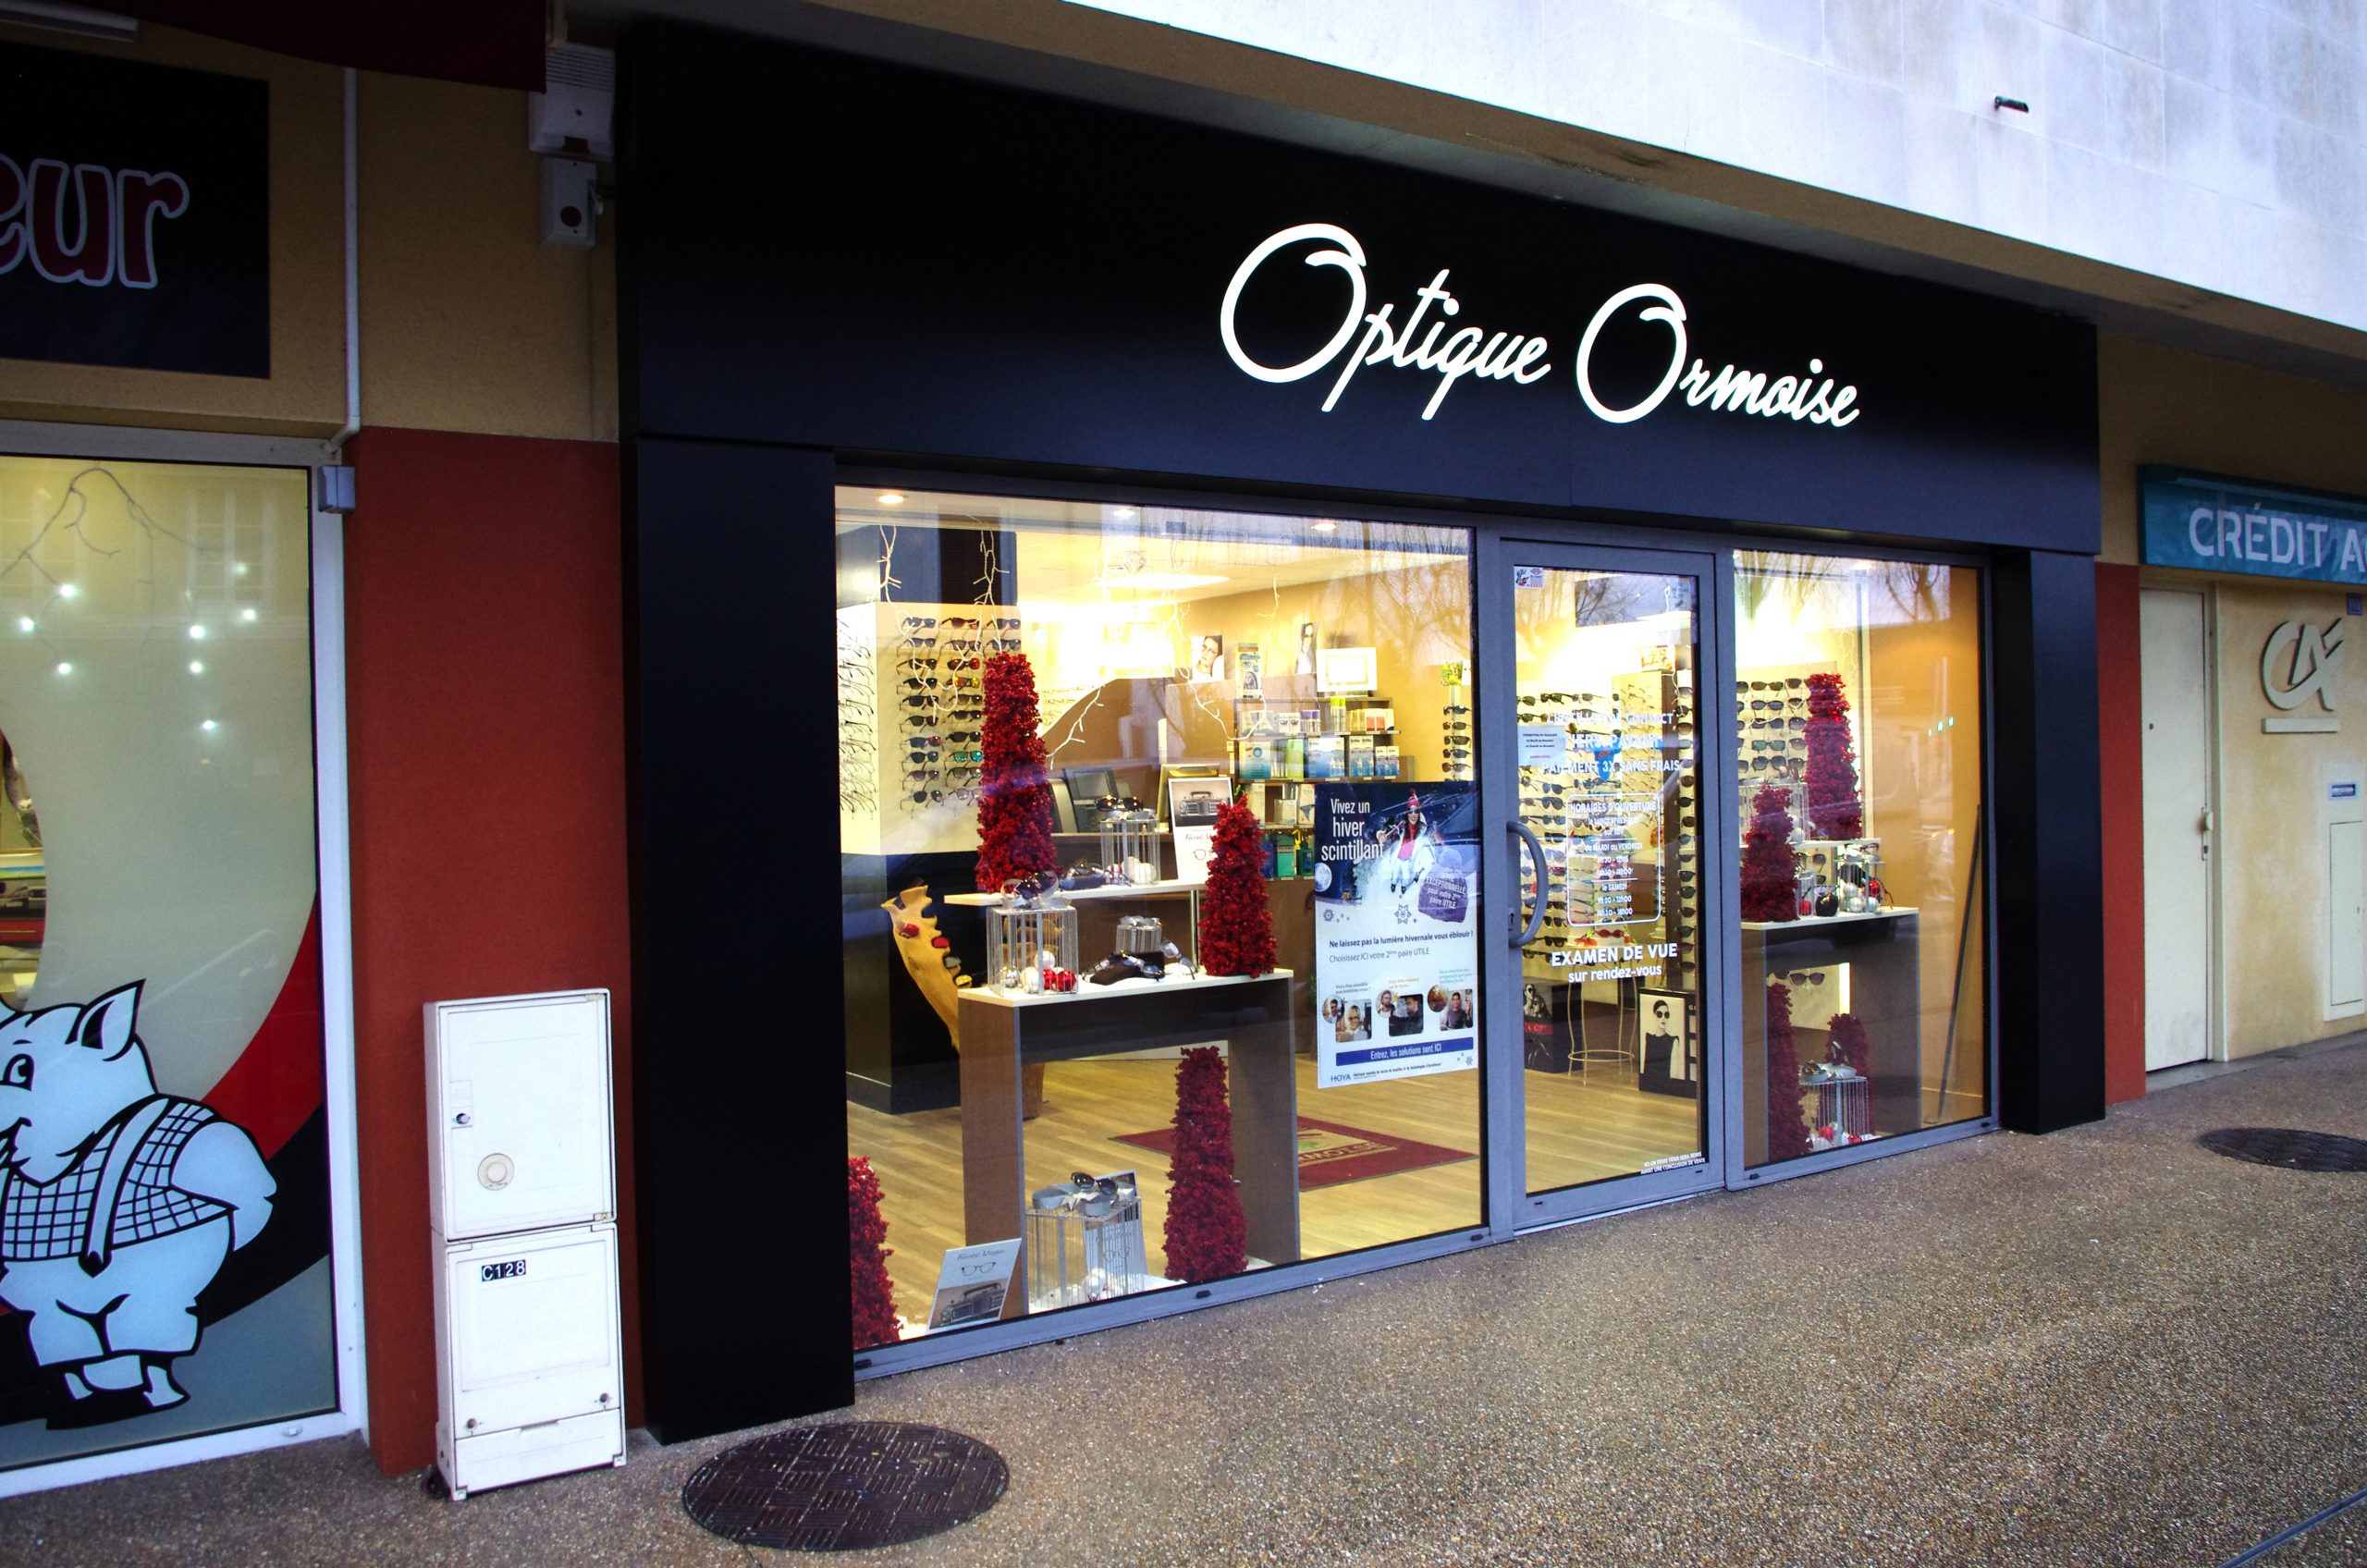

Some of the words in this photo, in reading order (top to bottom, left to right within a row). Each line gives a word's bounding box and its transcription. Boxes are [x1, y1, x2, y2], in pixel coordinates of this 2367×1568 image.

[1220, 222, 1552, 421] Optique
[1576, 282, 1861, 428] Ormoise
[2189, 502, 2329, 568] CRÉDIT
[2340, 528, 2367, 573] A
[1650, 759, 1680, 772] FRAIS
[1331, 799, 1355, 814] Vivez
[1358, 802, 1370, 814] un
[1570, 802, 1607, 814] HORAIRES
[1609, 801, 1657, 812] D'OUVERTURE
[1332, 816, 1365, 838] hiver
[1321, 839, 1384, 862] scintillant
[1339, 939, 1360, 948] laissez
[1361, 938, 1372, 947] pas
[1380, 936, 1404, 944] lumière
[1404, 933, 1433, 942] hivernale
[1449, 930, 1470, 938] éblouir
[1329, 954, 1360, 962] Choisissez
[1360, 952, 1368, 961] ICI
[1398, 949, 1413, 959] paire
[1413, 947, 1429, 956] UTILE
[1551, 947, 1618, 967] EXAMEN
[1623, 945, 1643, 961] DE
[1648, 942, 1678, 959] VUE
[1568, 971, 1588, 983] sur
[1590, 964, 1662, 981] rendez-vous
[1370, 1050, 1389, 1060] Entrez,
[1390, 1048, 1398, 1058] les
[1399, 1047, 1421, 1057] solutions
[1422, 1045, 1433, 1054] sont
[1331, 1073, 1352, 1083] HOYA
[482, 1260, 525, 1280] C128
